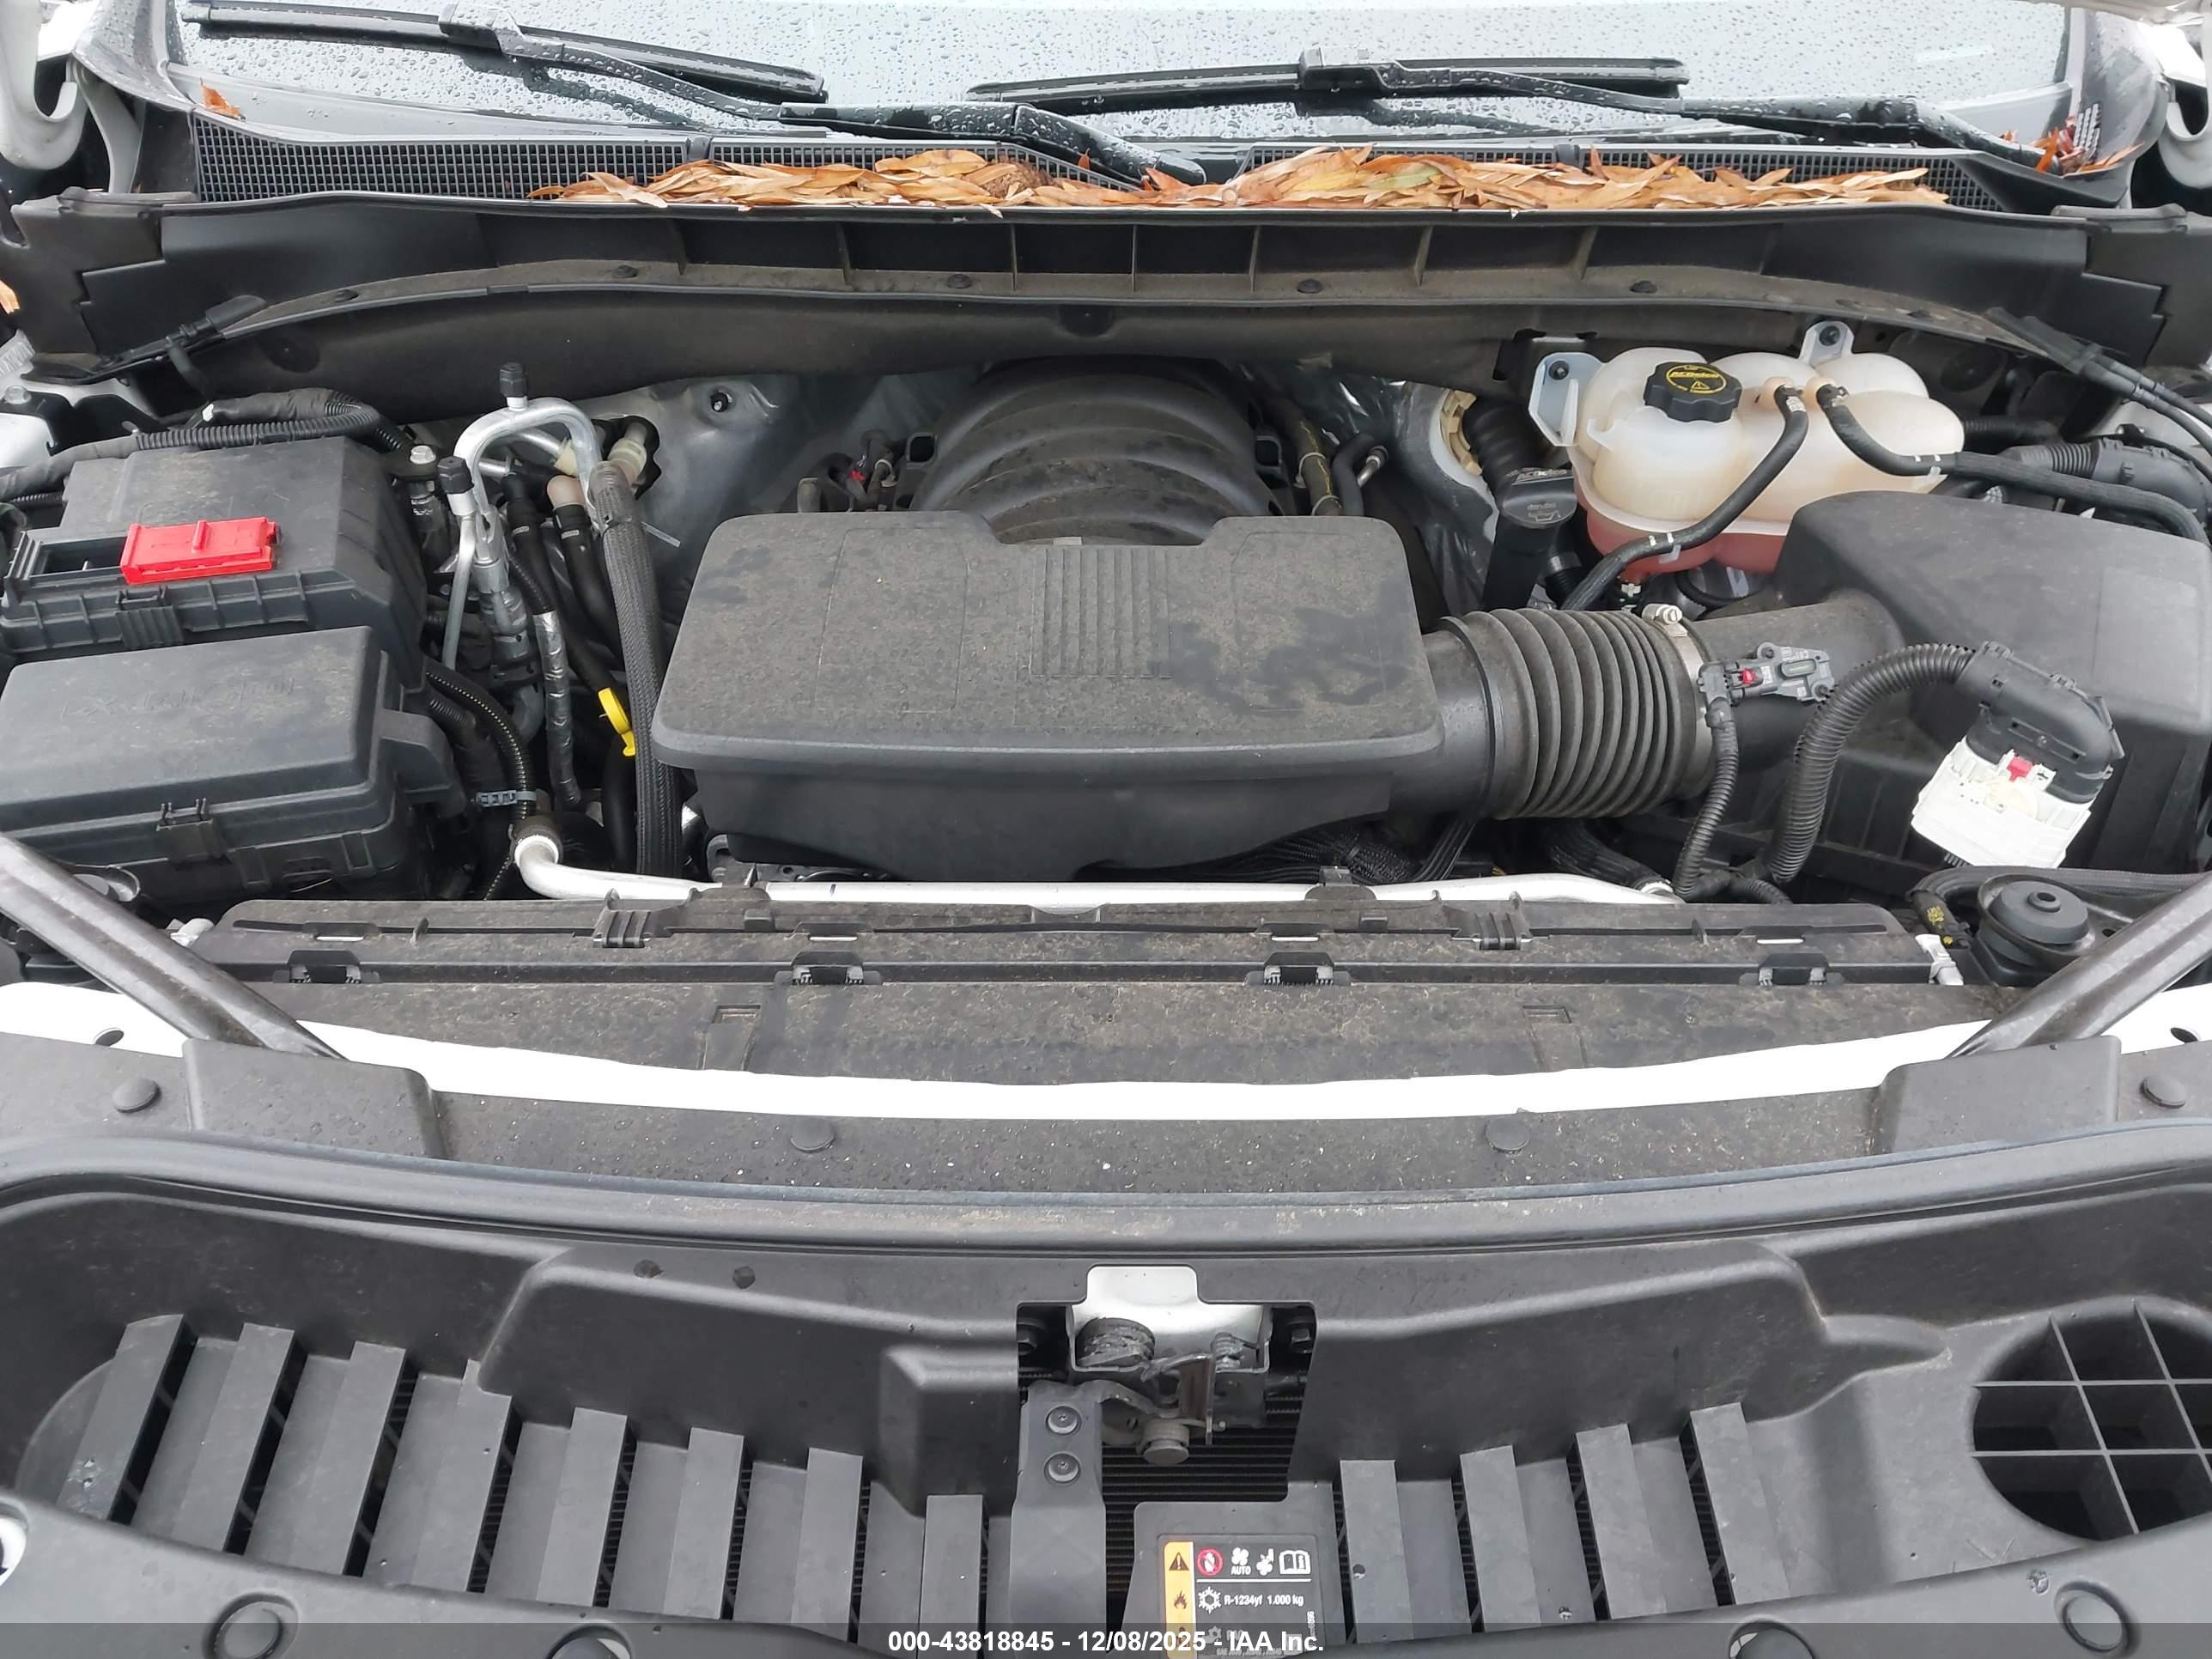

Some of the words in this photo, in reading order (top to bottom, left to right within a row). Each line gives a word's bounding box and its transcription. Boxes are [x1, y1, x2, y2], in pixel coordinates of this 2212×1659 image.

[1231, 1565, 1251, 1575] AUTO
[1224, 1594, 1263, 1607] R-1234yf
[1267, 1595, 1291, 1605] 1.000
[1291, 1594, 1304, 1607] kg
